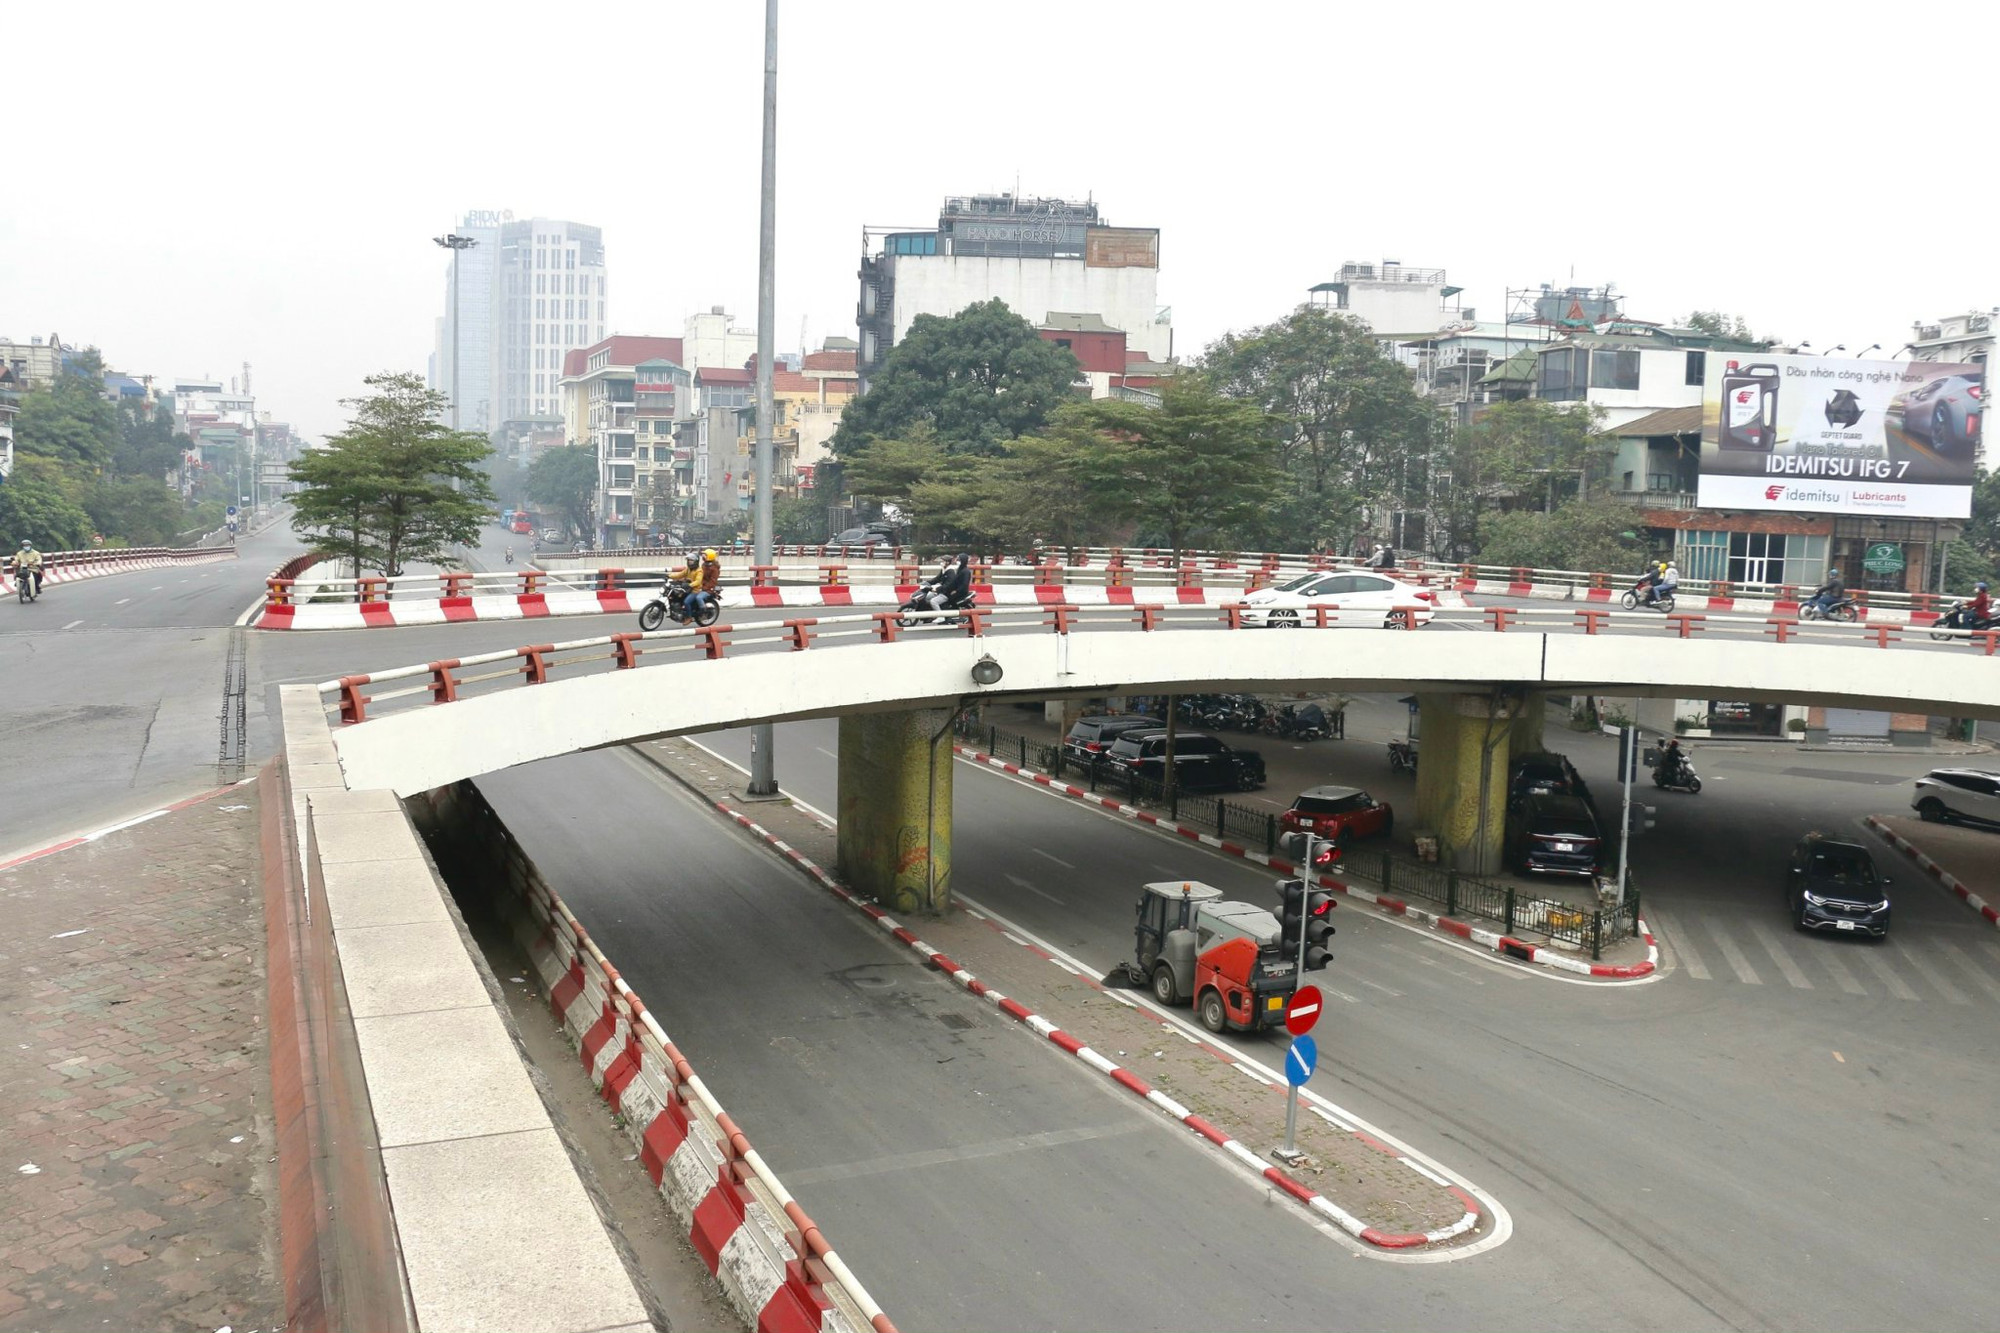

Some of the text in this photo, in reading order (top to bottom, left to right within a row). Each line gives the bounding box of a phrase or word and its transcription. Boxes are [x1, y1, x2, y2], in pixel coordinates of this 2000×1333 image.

[469, 209, 501, 223] BIDV
[1013, 229, 1058, 242] HORSE
[1894, 371, 1924, 382] Nano
[1765, 454, 1911, 479] IDEMITSU IFG 7
[1786, 487, 1907, 503] idemitsu Lubricants
